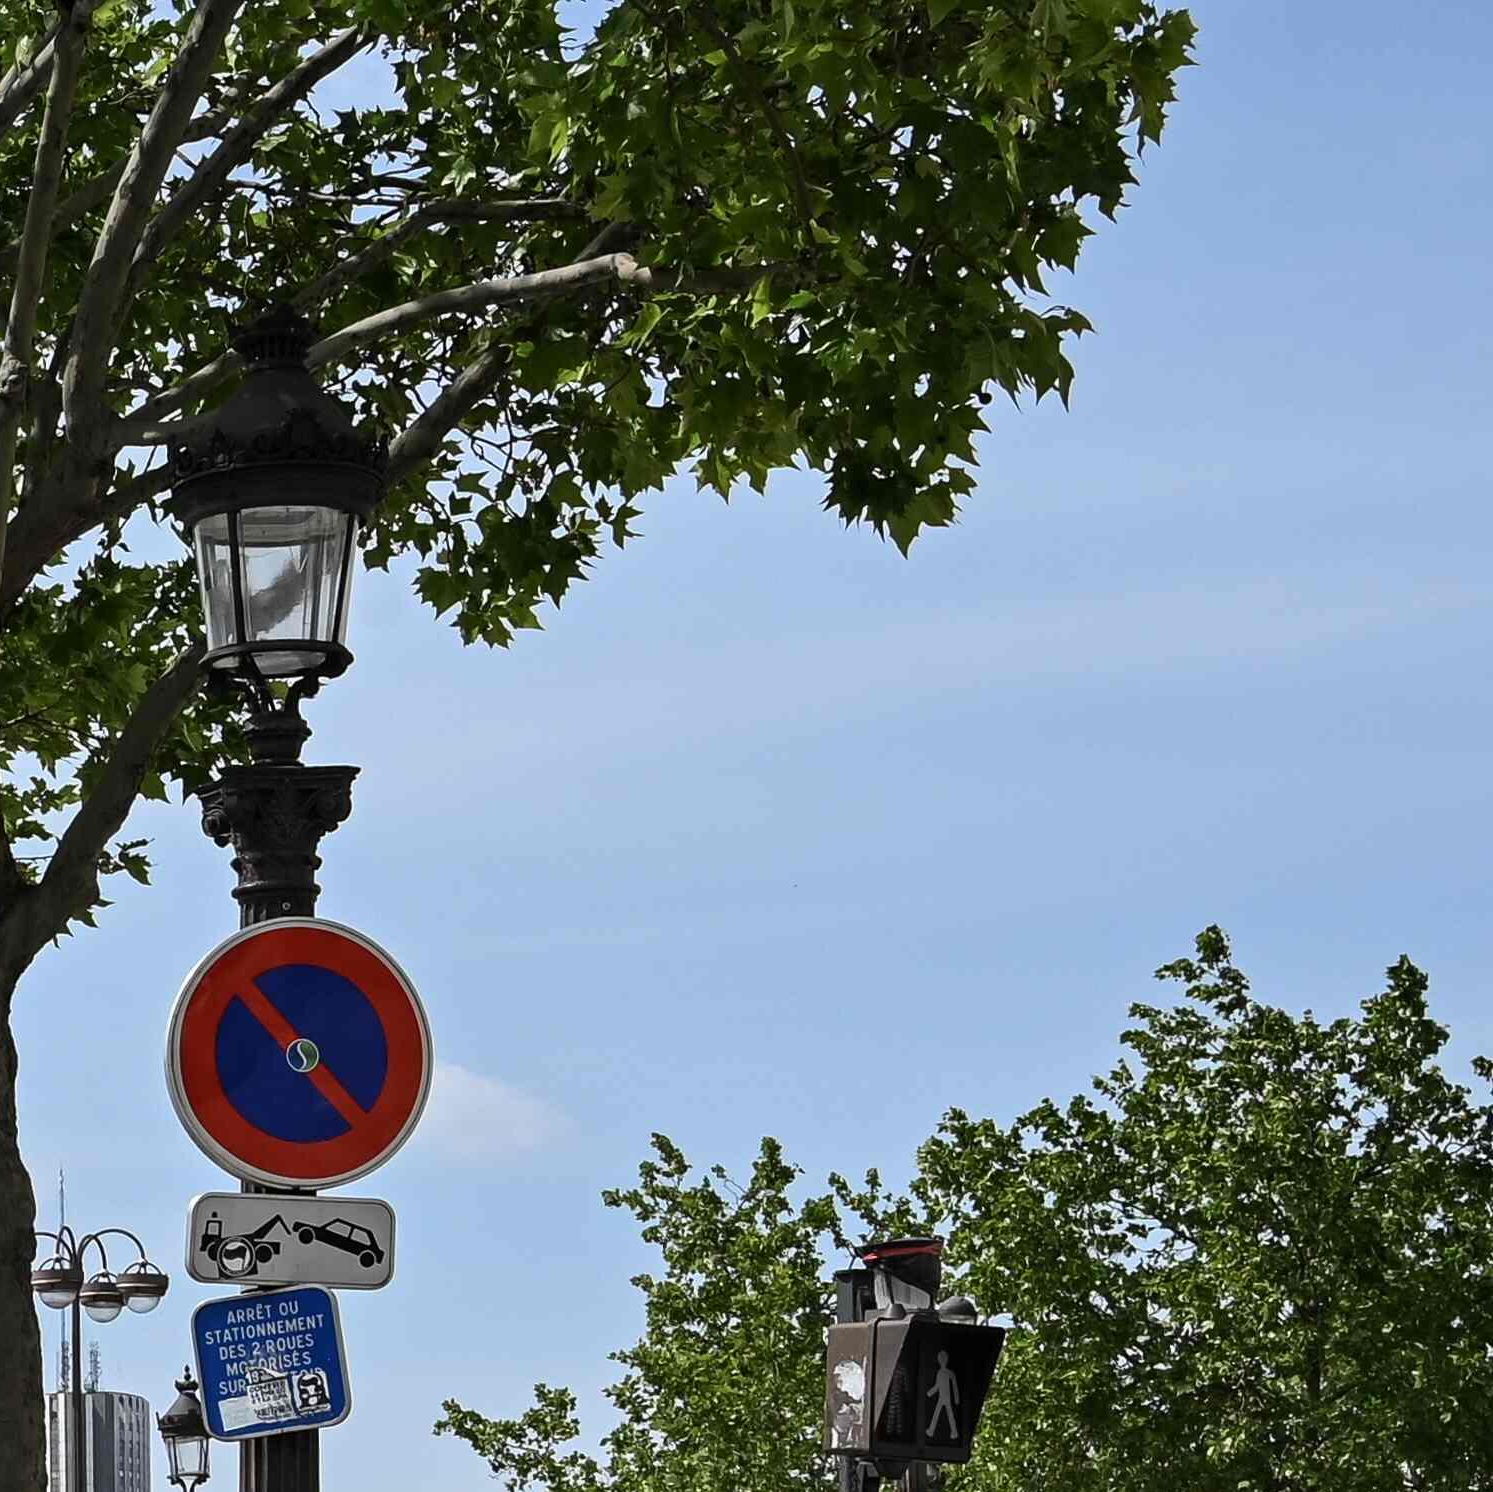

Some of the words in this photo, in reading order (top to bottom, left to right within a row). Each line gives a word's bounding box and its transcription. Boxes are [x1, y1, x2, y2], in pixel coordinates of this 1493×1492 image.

[226, 1303, 272, 1325] ARRÊT
[278, 1300, 299, 1316] OU
[204, 1313, 325, 1345] STATIONNEMENT
[219, 1343, 247, 1360] DES
[252, 1341, 261, 1356] 2
[265, 1333, 315, 1353] ROUES
[218, 1378, 247, 1395] SUR
